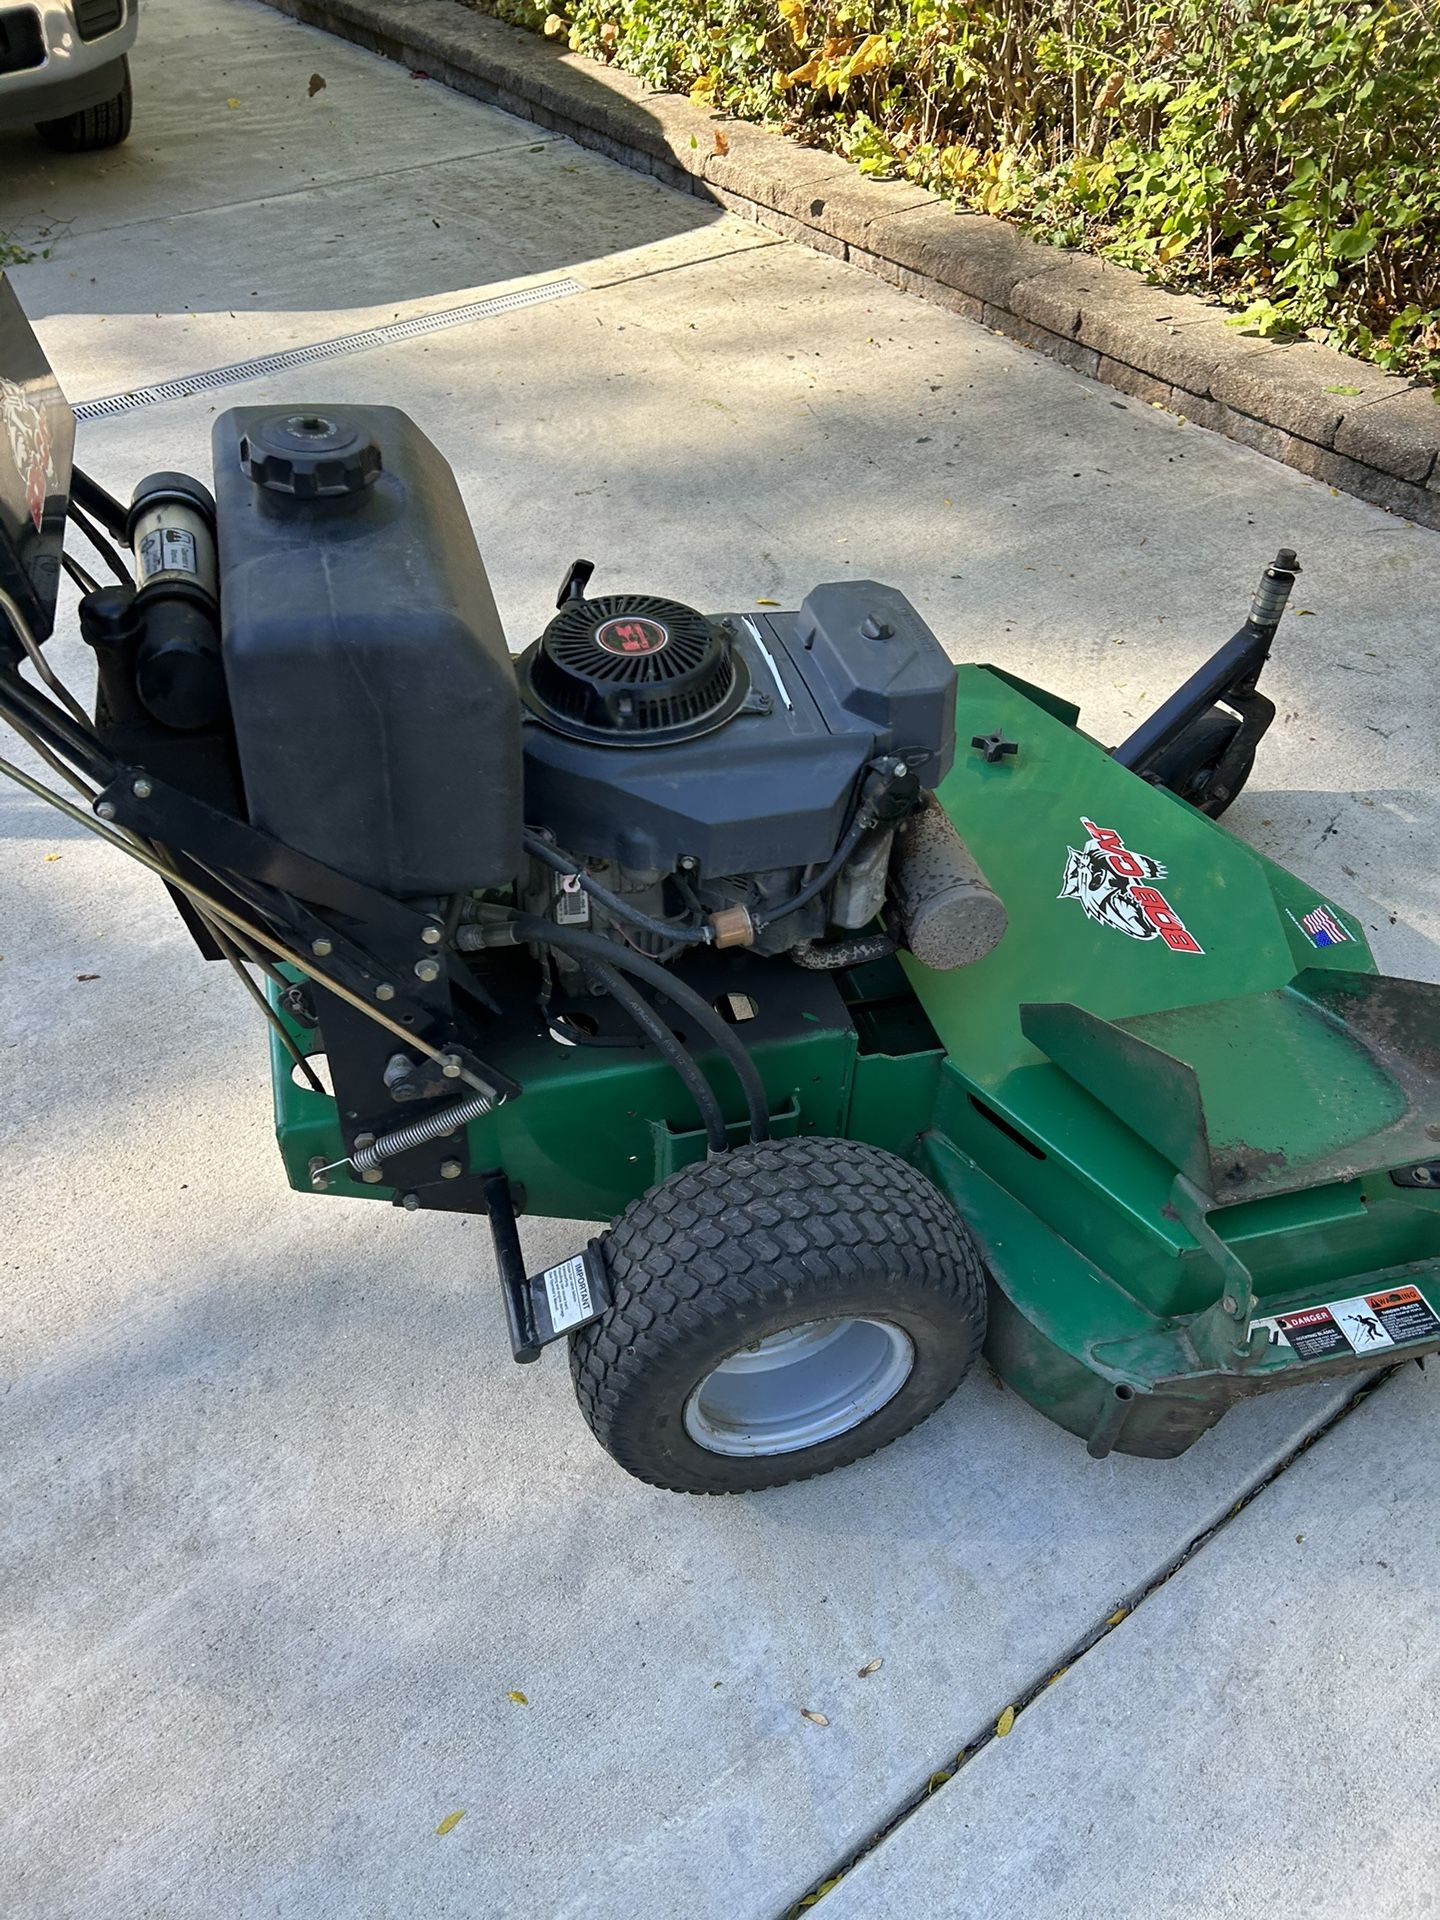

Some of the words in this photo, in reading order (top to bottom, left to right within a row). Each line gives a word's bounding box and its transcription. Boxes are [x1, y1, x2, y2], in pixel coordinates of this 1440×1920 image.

[574, 1263, 590, 1310] IMPORTANT
[1377, 1291, 1417, 1305] WAING
[1290, 1311, 1329, 1326] DANGER
